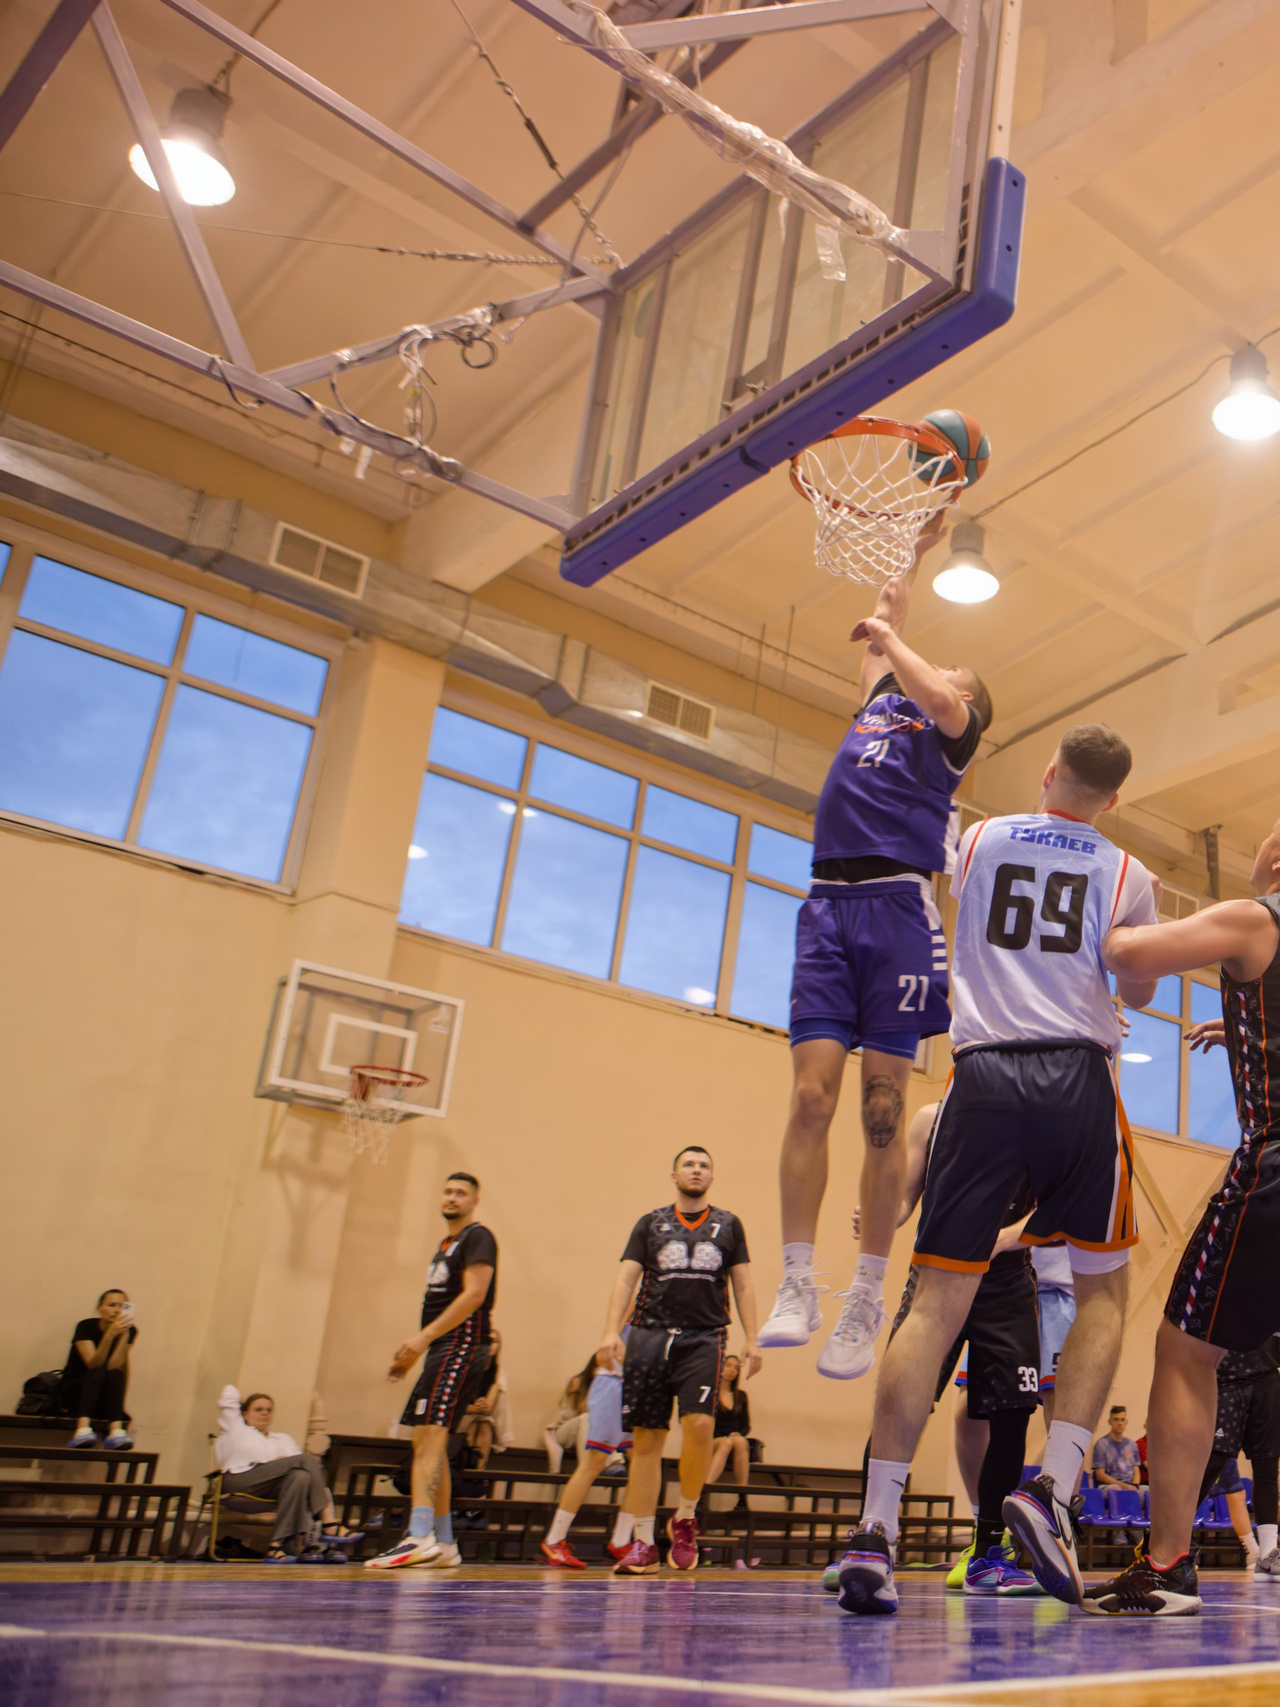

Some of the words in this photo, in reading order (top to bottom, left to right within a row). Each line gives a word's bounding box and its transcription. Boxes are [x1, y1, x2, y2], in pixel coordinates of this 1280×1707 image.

[856, 738, 890, 768] 21
[1010, 826, 1097, 856] ТУКАЕВ
[986, 863, 1089, 954] 69
[898, 974, 930, 1012] 21
[710, 1222, 721, 1239] 7
[698, 1385, 712, 1404] 7
[1017, 1366, 1039, 1393] 33
